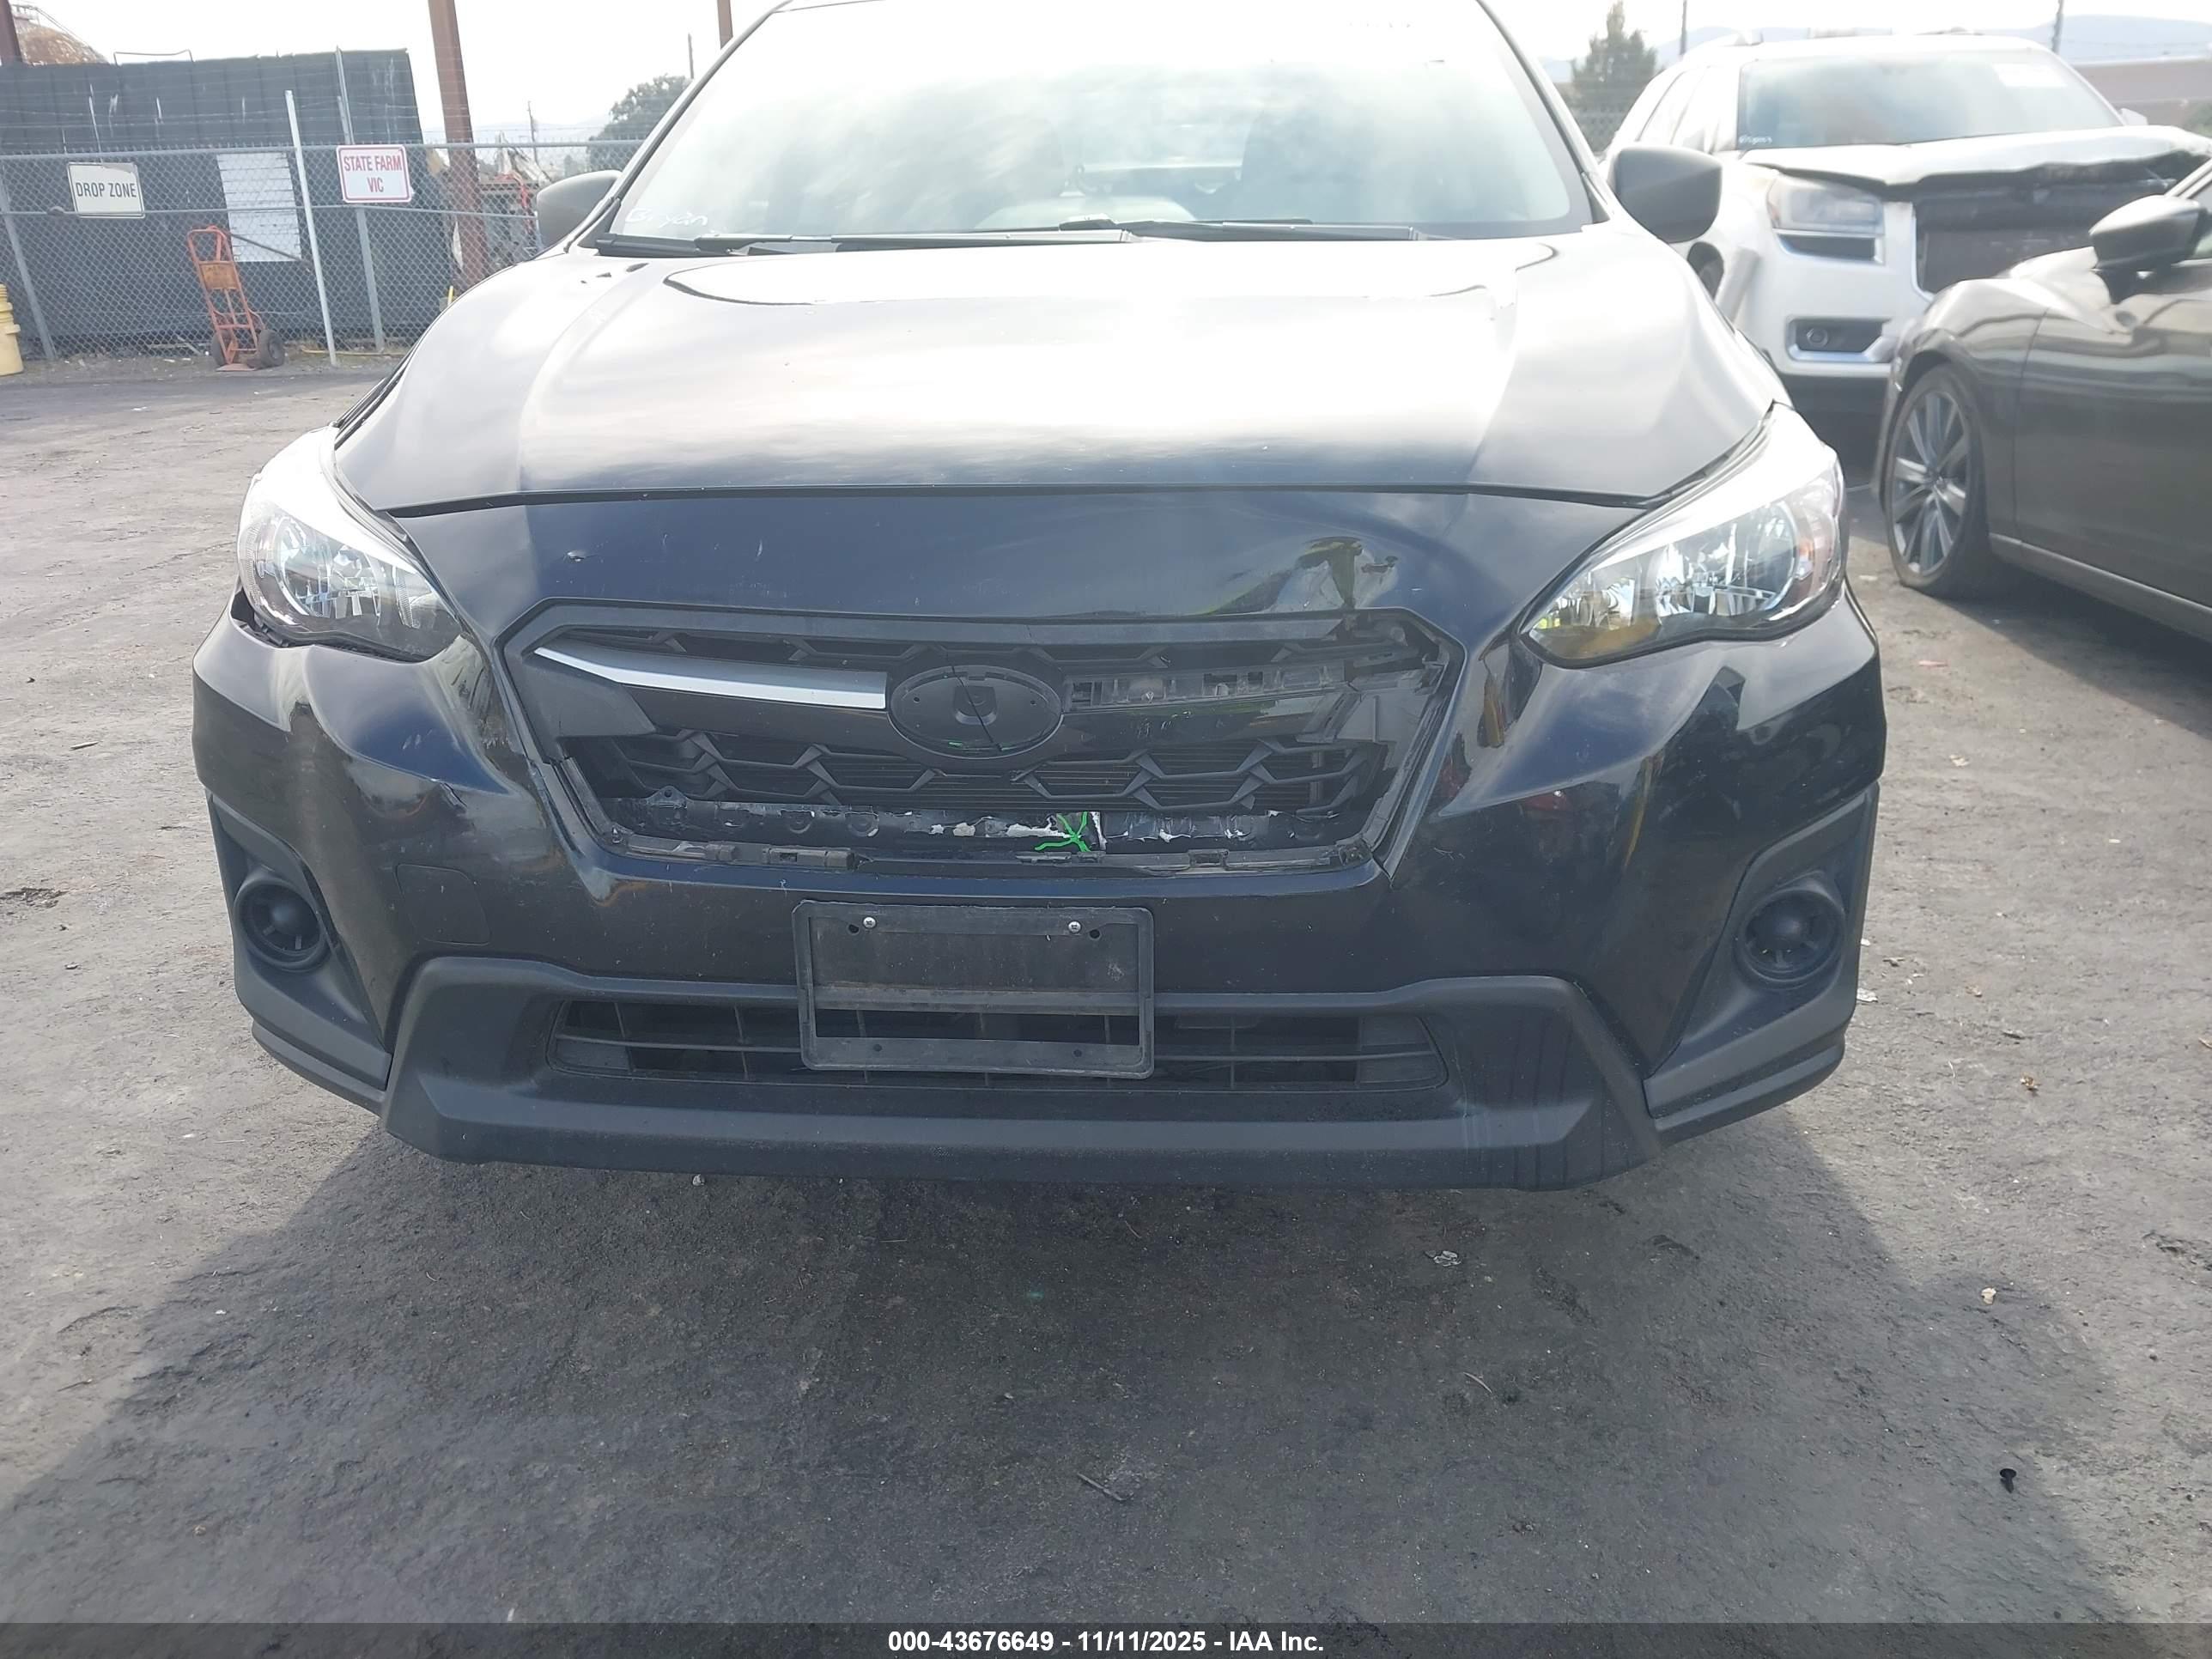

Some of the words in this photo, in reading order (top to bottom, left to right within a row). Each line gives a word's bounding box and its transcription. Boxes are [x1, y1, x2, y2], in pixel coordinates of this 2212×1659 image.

[343, 155, 373, 171] STATE
[374, 155, 402, 171] FARM
[76, 182, 105, 198] DROP
[107, 182, 137, 198] ZONE
[367, 177, 384, 192] VIC
